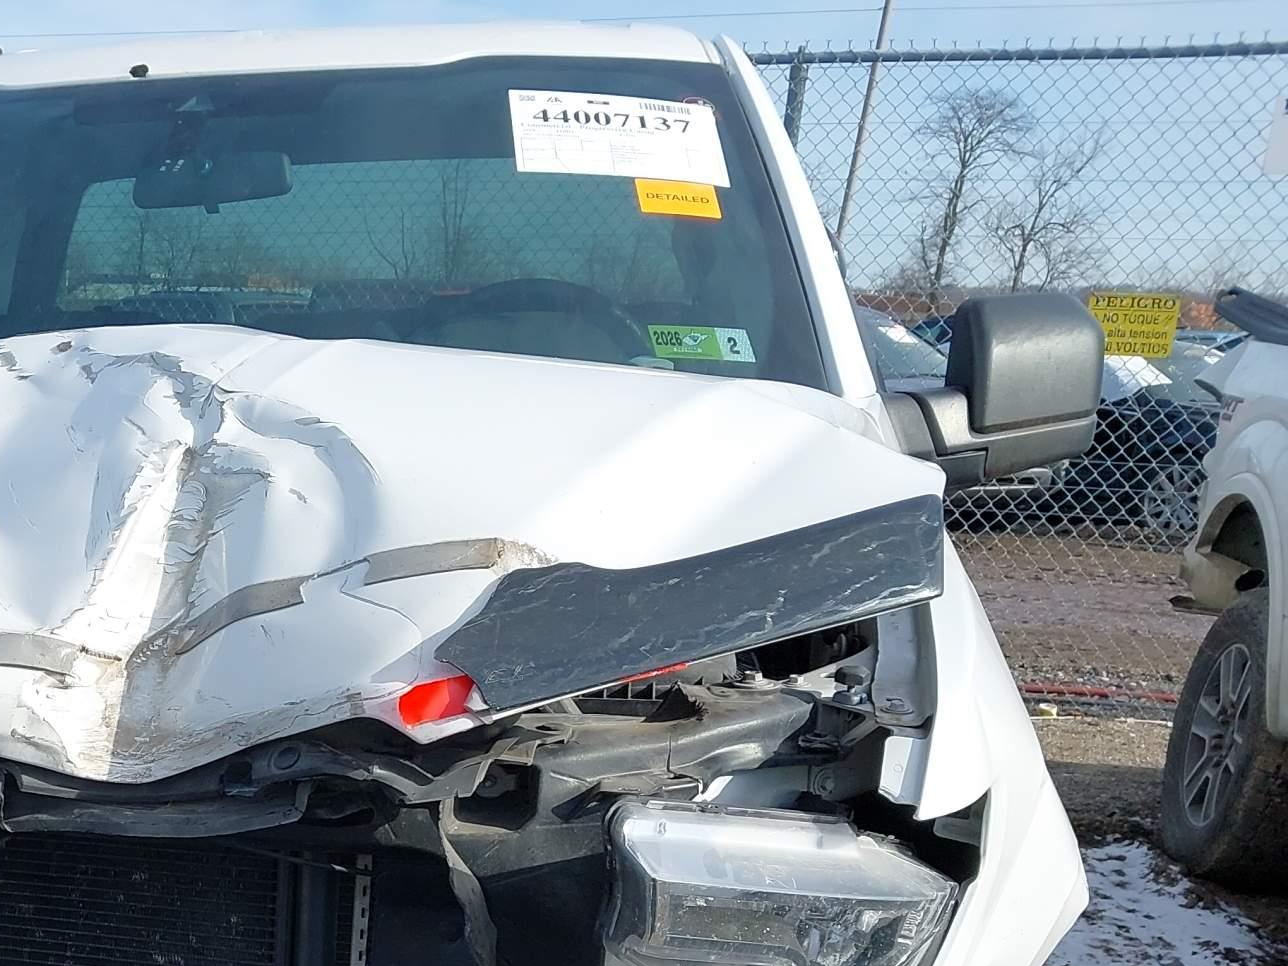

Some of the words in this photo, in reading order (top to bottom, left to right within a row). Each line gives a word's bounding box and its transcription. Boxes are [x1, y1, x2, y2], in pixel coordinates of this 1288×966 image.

[532, 108, 691, 134] 44007137
[645, 192, 711, 205] DETAILED
[1094, 296, 1177, 310] PELIGRO
[1102, 311, 1120, 324] NO
[1107, 327, 1126, 338] alta
[1129, 327, 1168, 340] tension
[653, 330, 683, 347] 2026
[727, 336, 741, 355] 2
[1115, 341, 1170, 355] VOLTIOS
